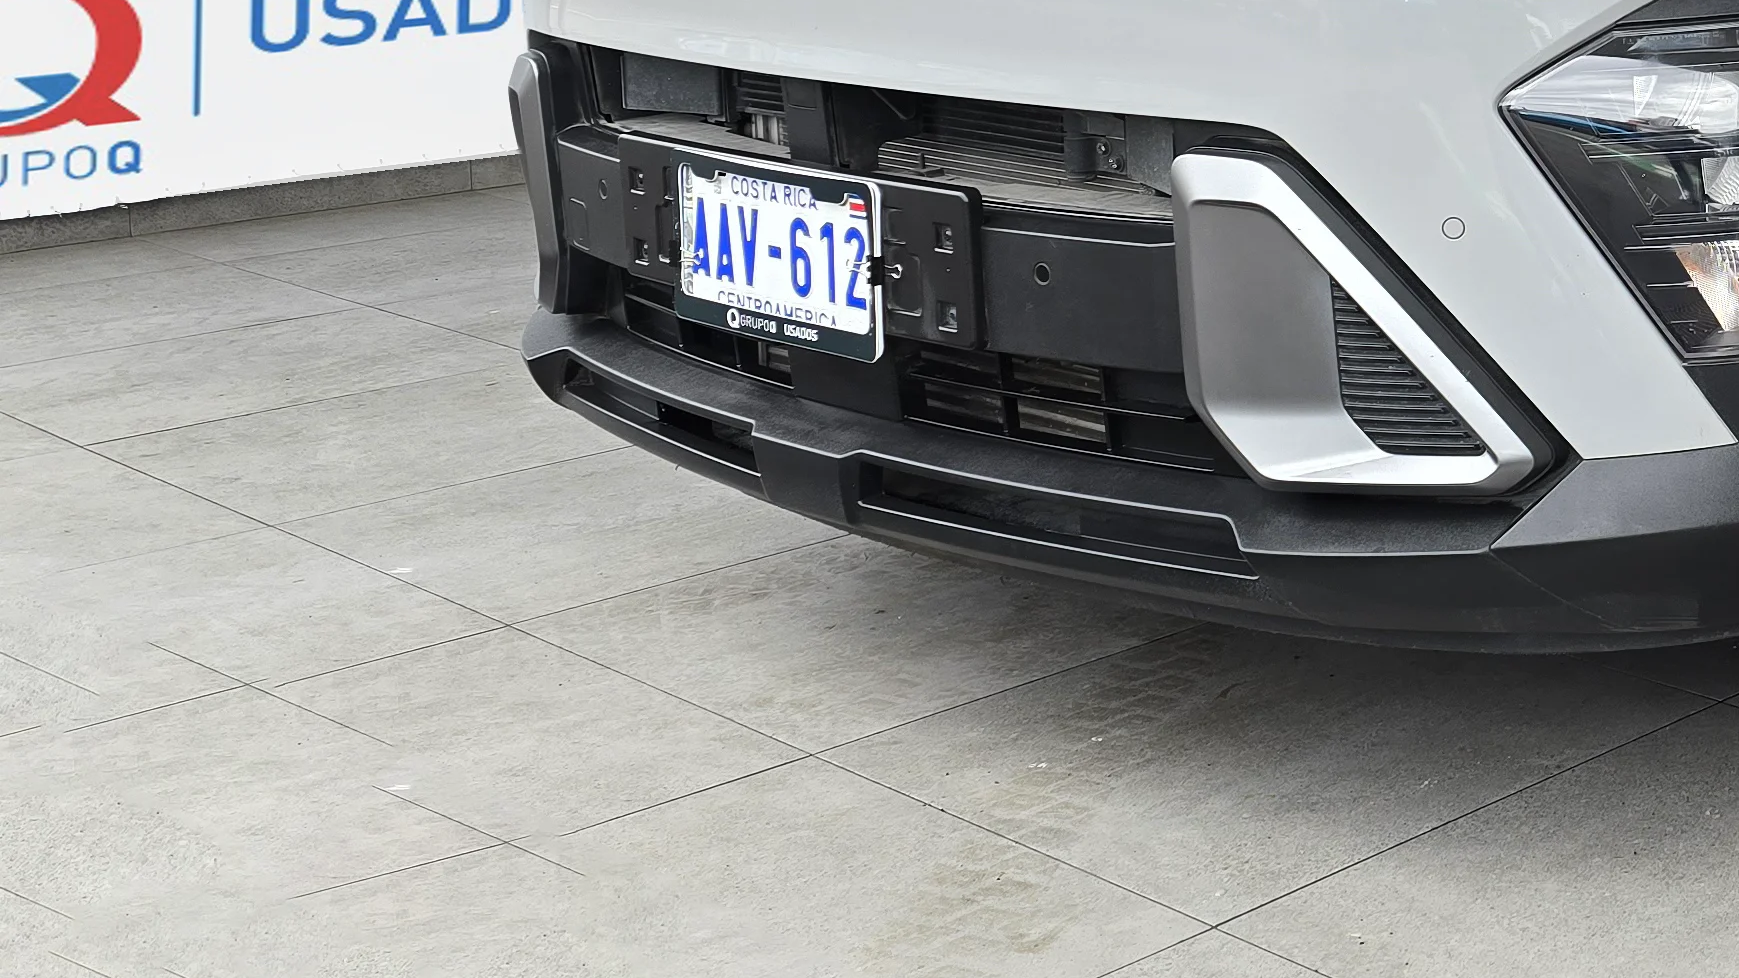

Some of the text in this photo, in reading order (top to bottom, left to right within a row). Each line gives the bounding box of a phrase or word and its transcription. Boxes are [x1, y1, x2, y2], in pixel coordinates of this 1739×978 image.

[730, 175, 779, 203] COSTA
[783, 185, 819, 211] RICA
[691, 196, 868, 312] AAV-612
